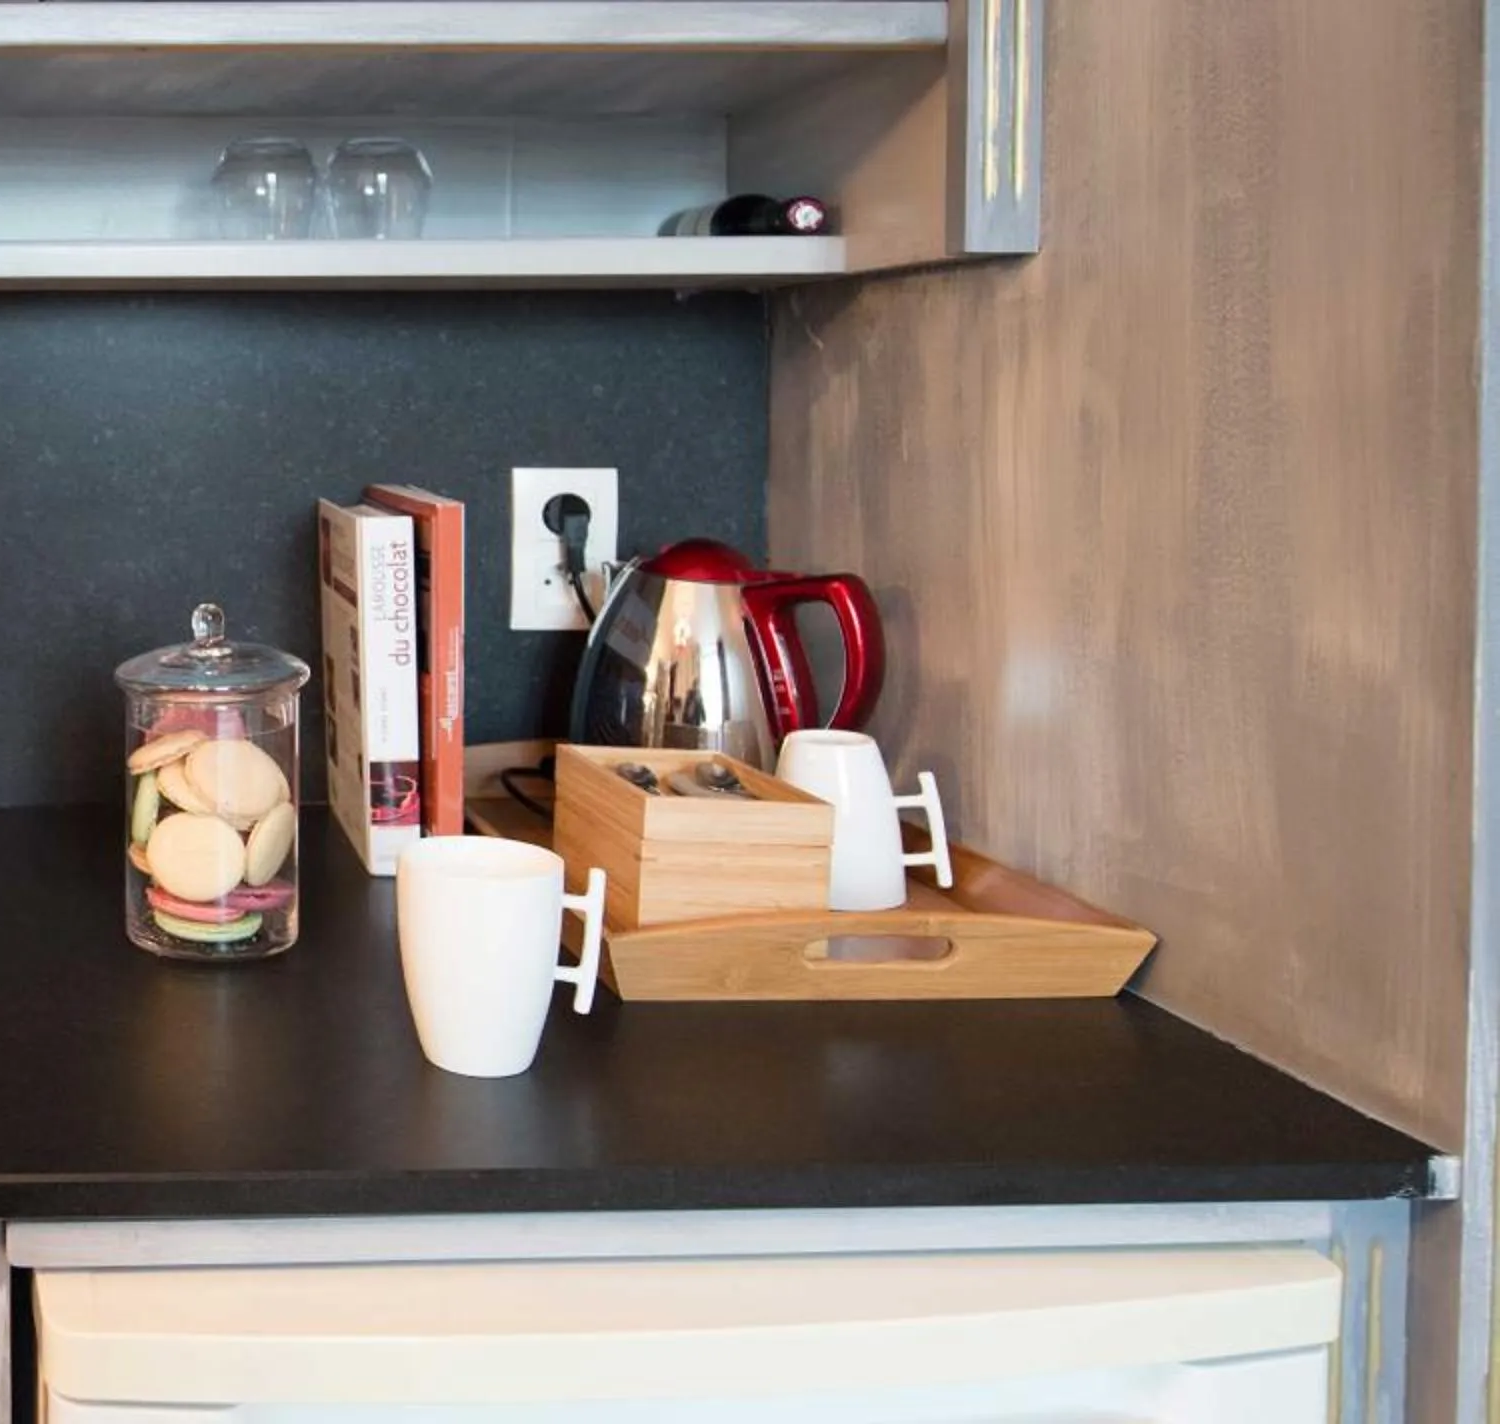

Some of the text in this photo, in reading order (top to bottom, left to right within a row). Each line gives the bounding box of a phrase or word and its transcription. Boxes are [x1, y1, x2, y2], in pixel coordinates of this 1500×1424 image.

[372, 545, 386, 622] LAROUSSE
[387, 541, 411, 667] du chocolat
